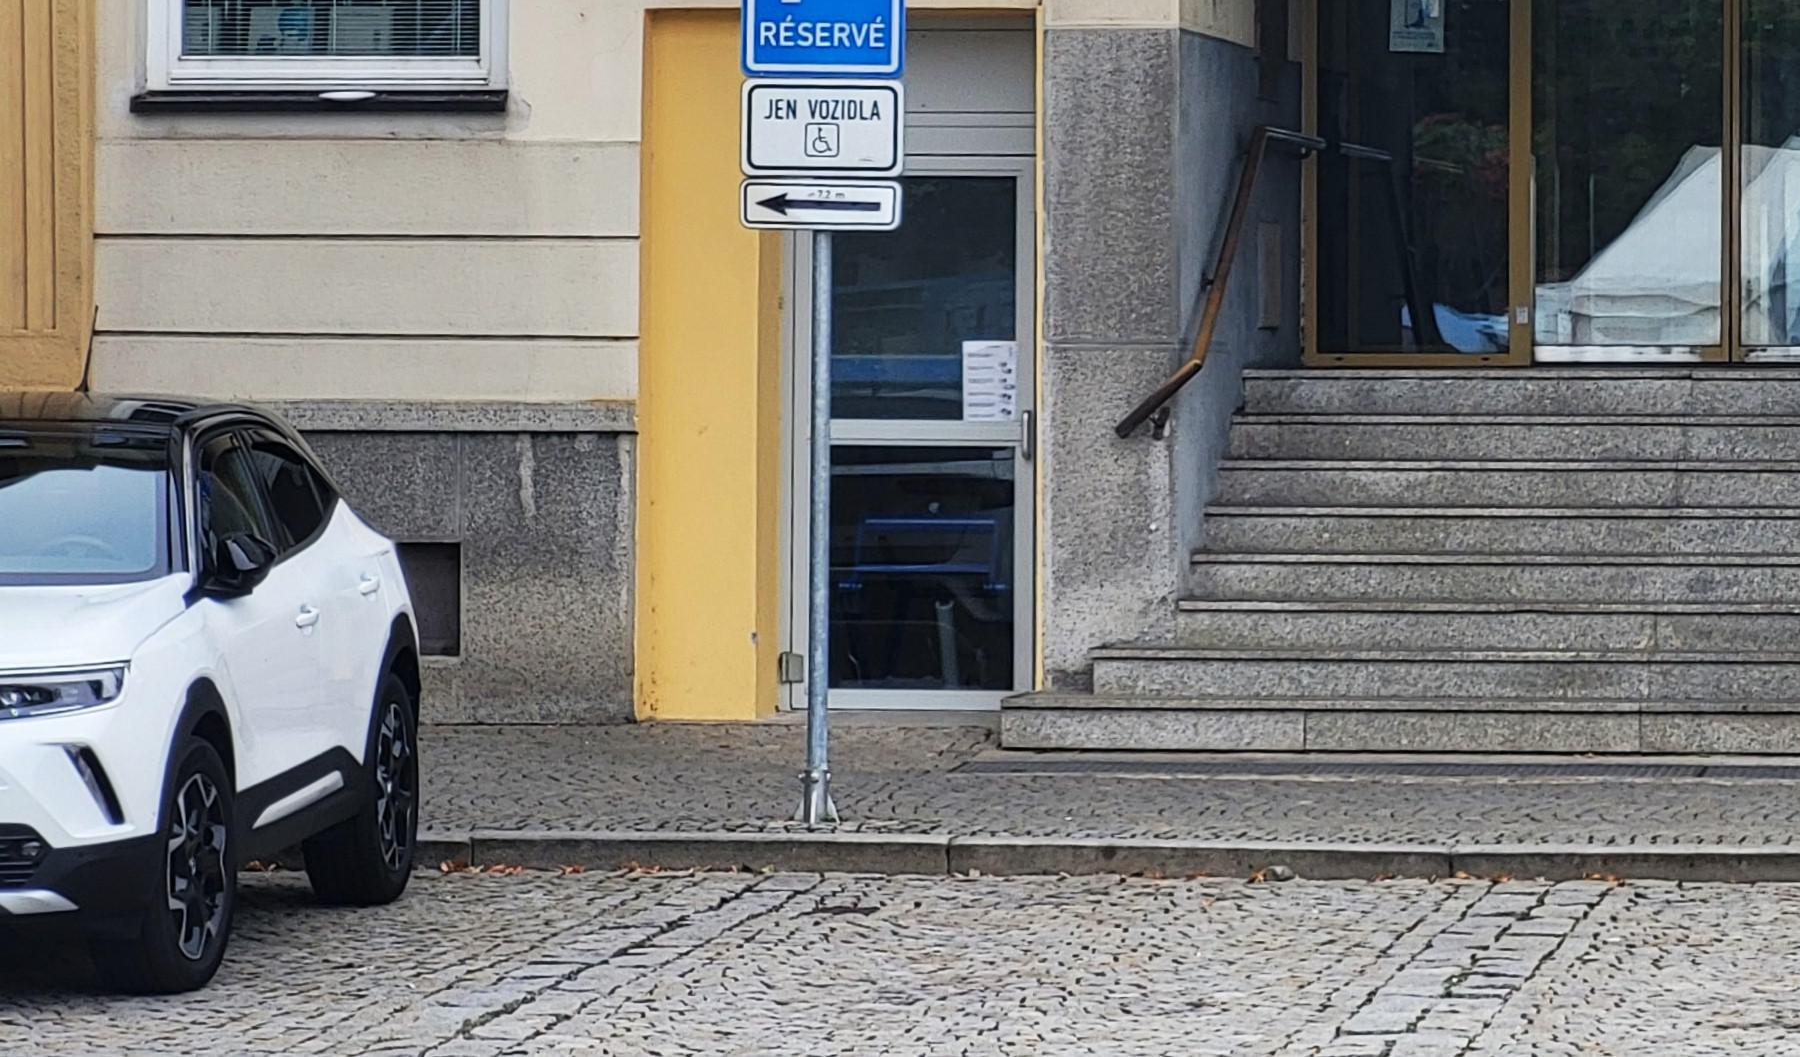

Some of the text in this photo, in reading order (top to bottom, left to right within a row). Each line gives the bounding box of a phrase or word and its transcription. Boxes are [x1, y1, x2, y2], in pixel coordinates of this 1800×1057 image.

[759, 14, 887, 48] RÉSERVÉ
[763, 98, 882, 121] JEN VOZIDLA
